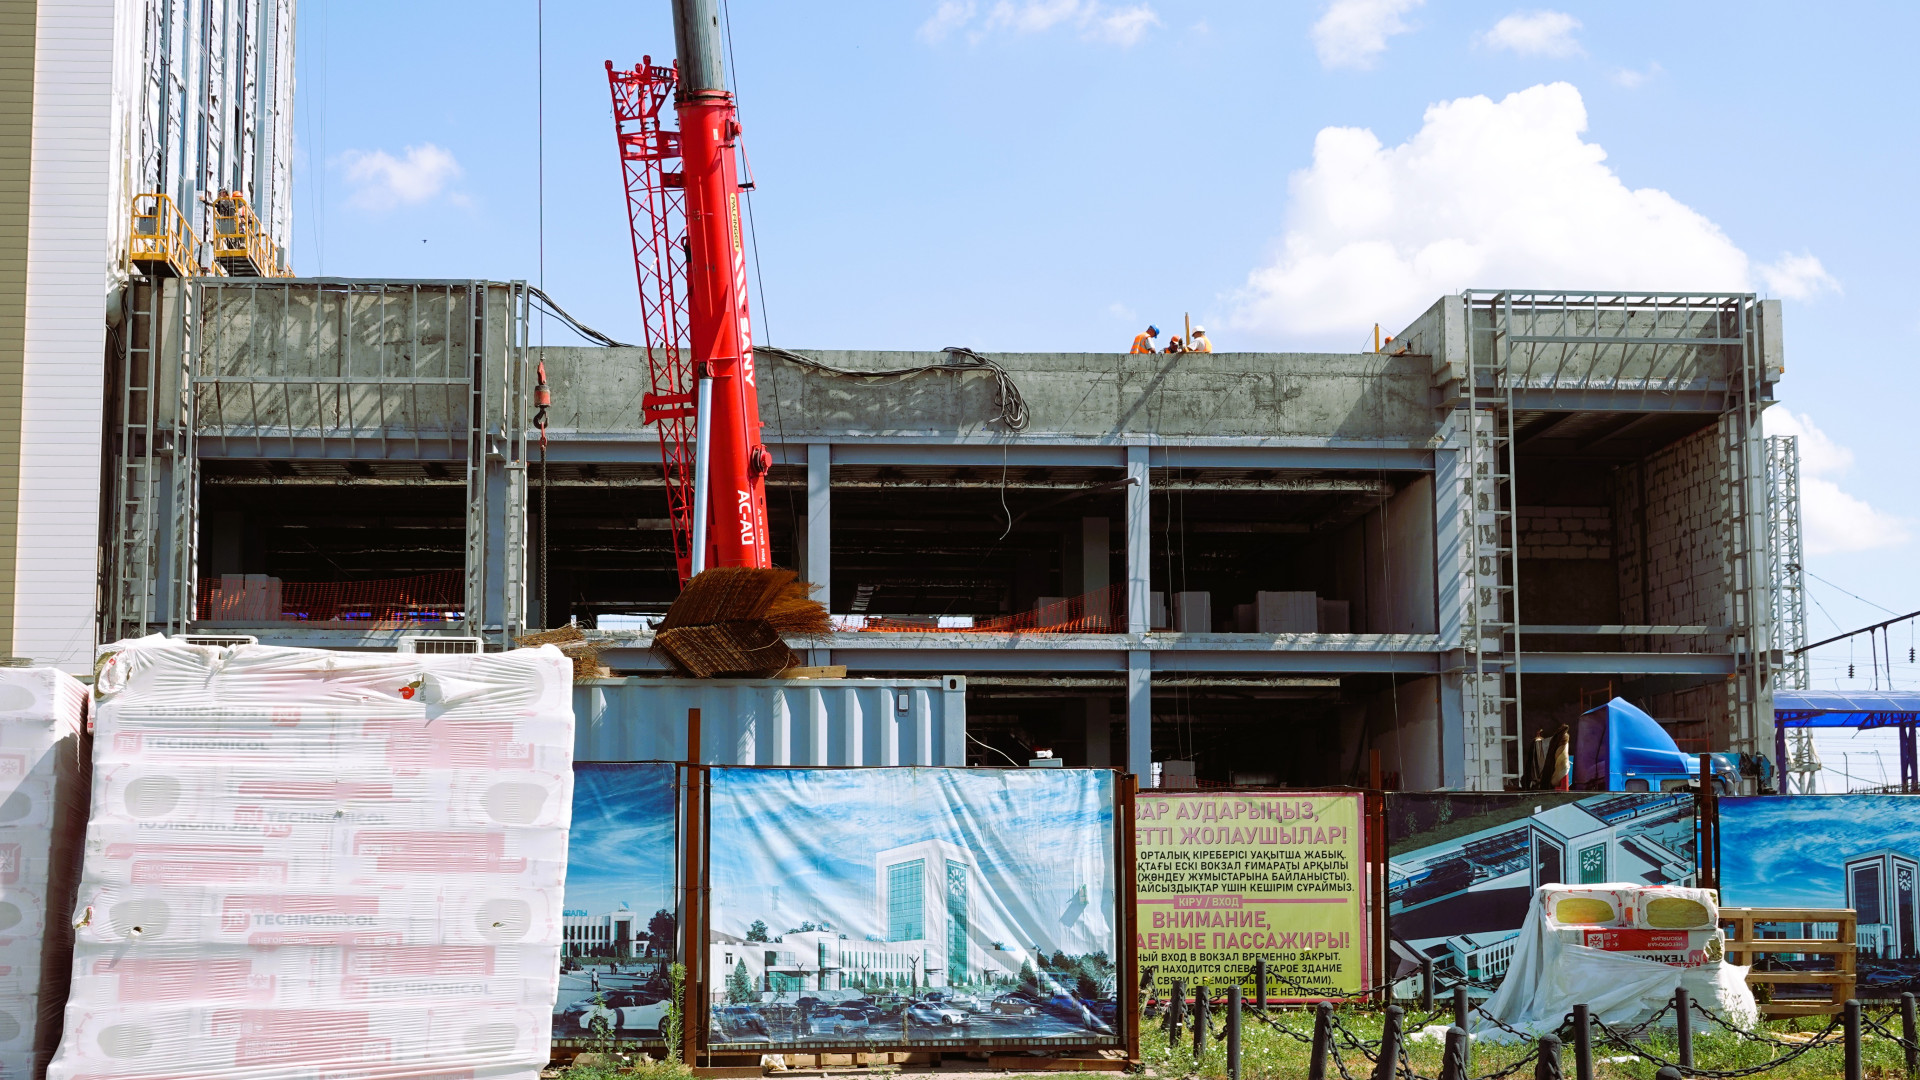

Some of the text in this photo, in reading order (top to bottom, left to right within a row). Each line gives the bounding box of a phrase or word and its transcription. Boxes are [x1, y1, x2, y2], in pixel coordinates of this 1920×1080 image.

[731, 196, 740, 248] PALFINGER
[740, 317, 755, 387] SANY
[267, 811, 385, 824] TECHNOICOL
[1176, 801, 1319, 823] АУДАРЫҢЫЗ,
[1180, 826, 1347, 845] ЖОЛАУШЫЛАР!
[1141, 850, 1346, 861] ОРТАЛЫҚ КІРЕБЕРІСІ УАҚЫТША ЖАБЫҚ.
[1136, 861, 1349, 872] ҚТАҒЫ ЕСКІ ВОКЗАЛ ҒИМАРАТЫ АРҚЫЛЫ
[1138, 870, 1349, 883] (ЖӨНДЕУ ЖҰМЫСТАРЫНА БАЙЛАНЫСТЫ).
[1221, 883, 1247, 892] ҮШІН
[1250, 883, 1294, 892] КЕШІРІМ
[1297, 881, 1355, 892] СҰРАЙМЫЗ.
[1179, 898, 1203, 907] КІРУ
[1212, 897, 1240, 907] ВХОД
[254, 914, 378, 926] TECHNONICOL
[1152, 911, 1271, 931] ВНИМАНИЕ,
[1213, 932, 1350, 949] ПАССАЖИРЫ!
[1161, 952, 1187, 963] ВХОД
[1190, 953, 1197, 961] В
[1200, 952, 1239, 961] ВОКЗАЛ
[1242, 952, 1297, 961] ВРЕМЕННО
[1299, 952, 1341, 961] ЗАКРЫТ.
[1162, 964, 1221, 974] НАХОДИТСЯ
[1266, 964, 1299, 973] ТАРОЕ
[1301, 964, 1342, 974] ЗДАНИЕ
[1193, 976, 1199, 985] С
